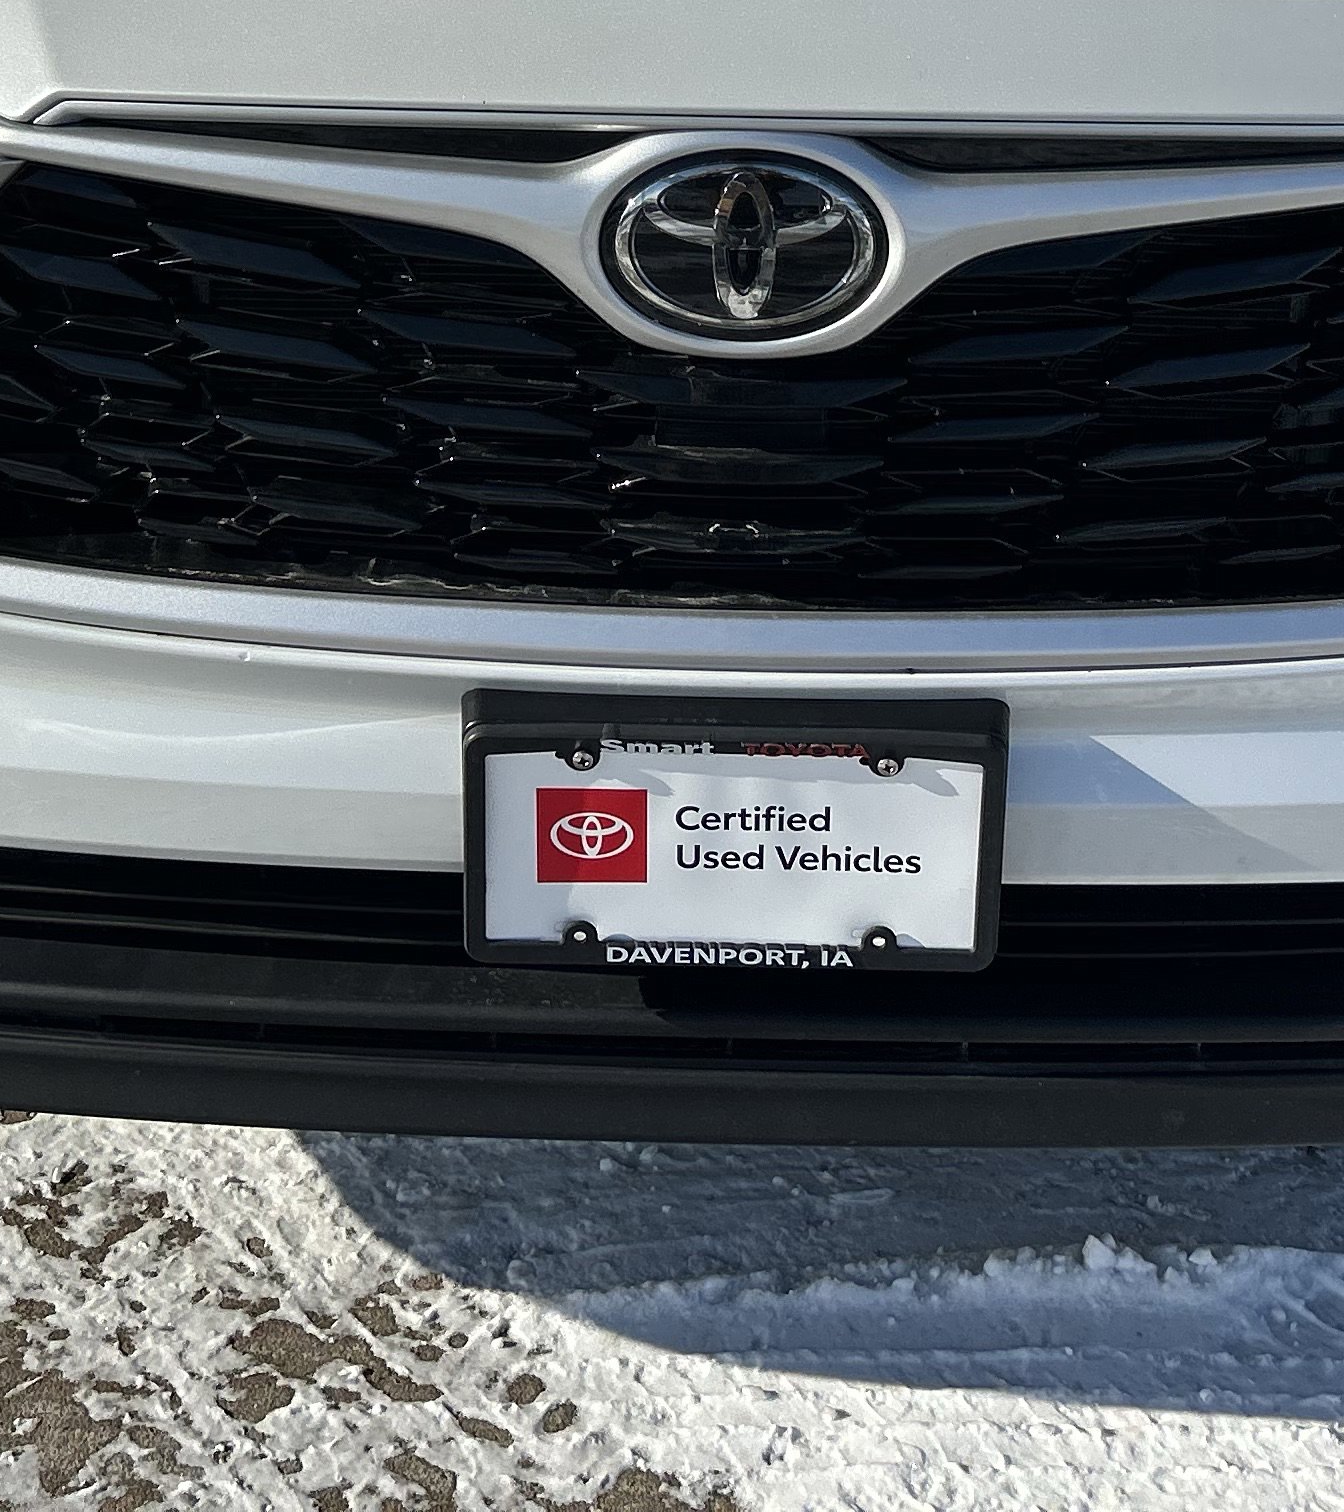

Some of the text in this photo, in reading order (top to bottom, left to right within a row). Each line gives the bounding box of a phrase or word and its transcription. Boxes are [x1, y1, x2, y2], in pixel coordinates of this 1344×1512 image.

[600, 739, 870, 759] Smart TOYOTA
[675, 805, 832, 833] Certified
[675, 844, 923, 875] Used Vehicles
[607, 946, 854, 969] DAVENPORT, IA
